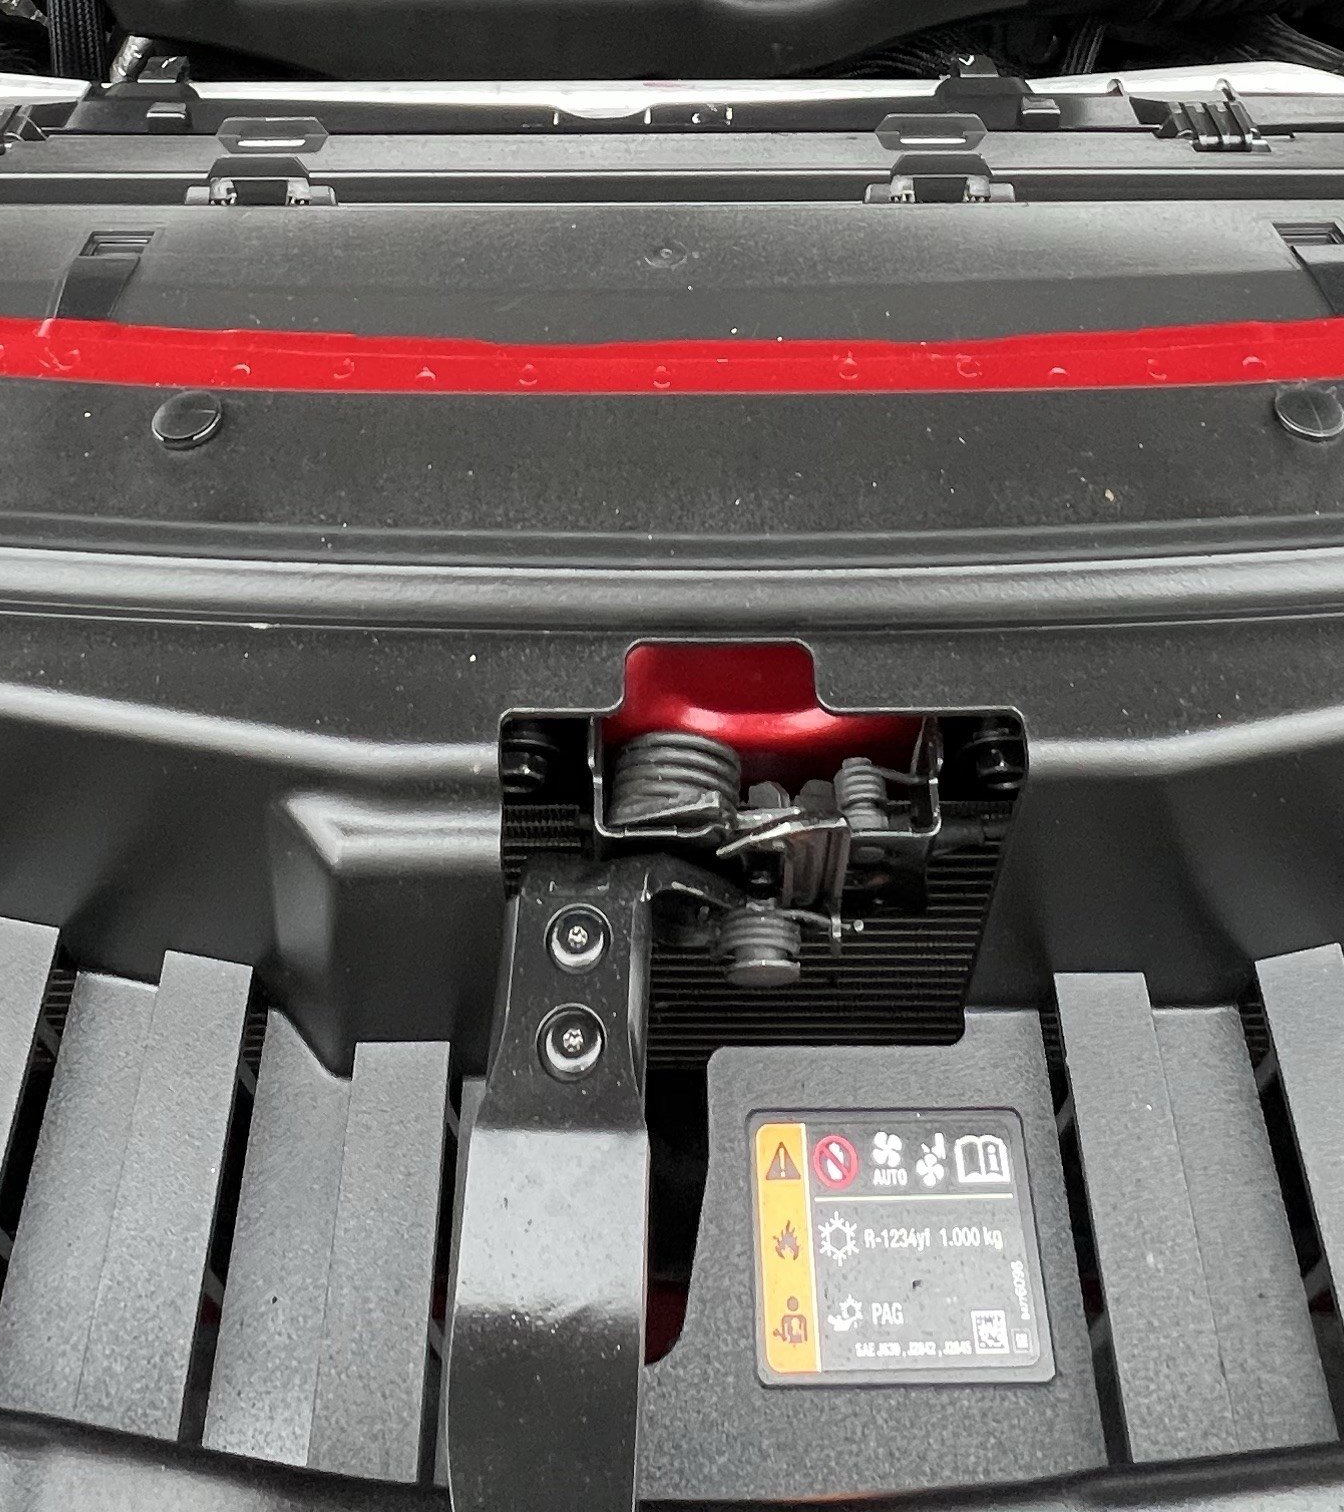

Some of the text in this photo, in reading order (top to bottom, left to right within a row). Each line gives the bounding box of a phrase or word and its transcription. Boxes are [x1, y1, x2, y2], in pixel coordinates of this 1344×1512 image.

[872, 1168, 908, 1186] AUTO
[863, 1226, 1004, 1252] R-1234yf 1.000 kg
[871, 1302, 905, 1326] PAG
